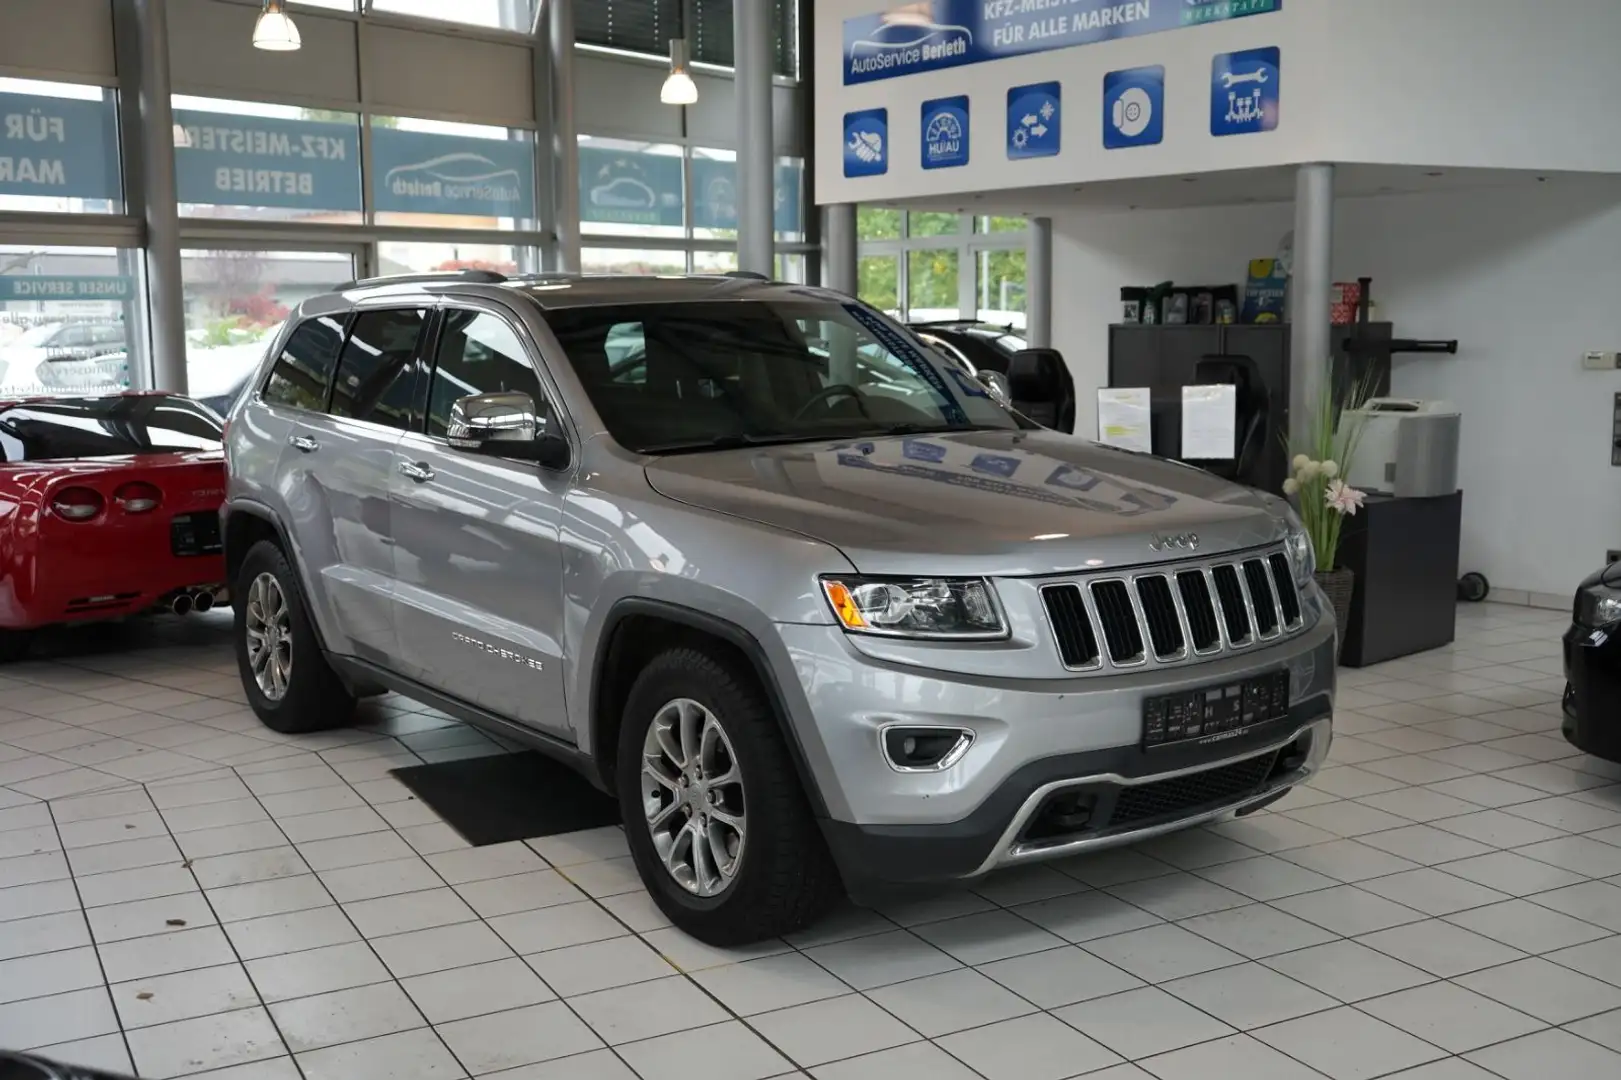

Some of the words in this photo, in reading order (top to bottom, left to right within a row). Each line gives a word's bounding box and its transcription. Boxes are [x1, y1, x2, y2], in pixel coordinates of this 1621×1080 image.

[993, 22, 1024, 47] FÜR
[1028, 16, 1068, 41] ALLE
[1072, 0, 1149, 32] MARKEN
[851, 46, 920, 75] AutoService
[922, 36, 966, 61] Berleth
[1149, 531, 1199, 552] Jeep
